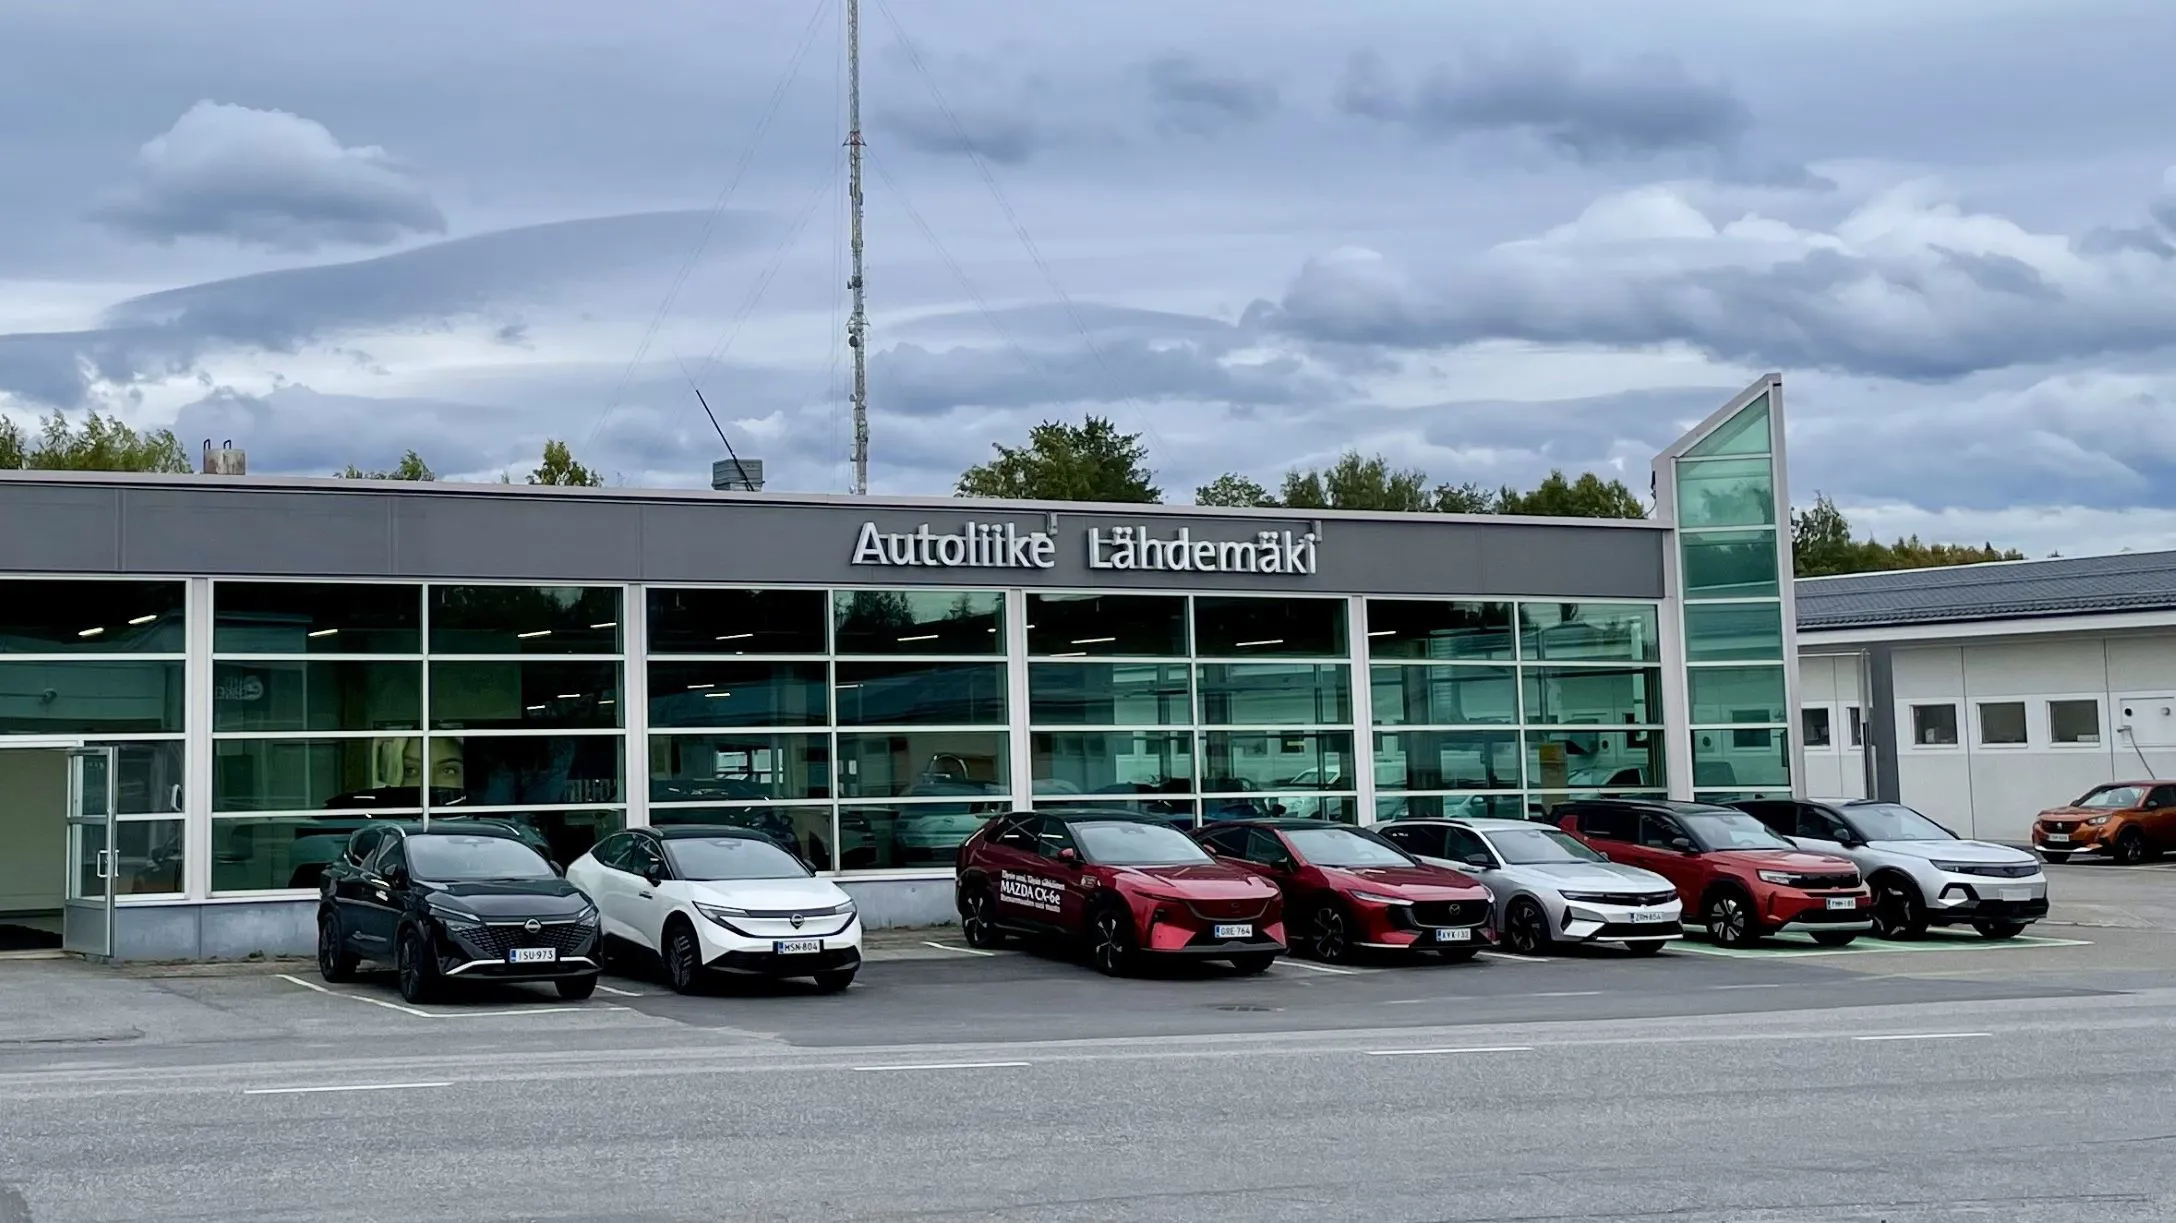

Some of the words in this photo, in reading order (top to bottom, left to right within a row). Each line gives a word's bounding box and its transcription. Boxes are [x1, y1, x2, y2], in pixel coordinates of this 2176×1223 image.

[852, 522, 1055, 568] Autoliike
[1087, 526, 1316, 574] Lähdemäki
[1000, 880, 1034, 900] MAZDA
[1034, 887, 1060, 905] CX-6e
[518, 949, 553, 961] ISU-973
